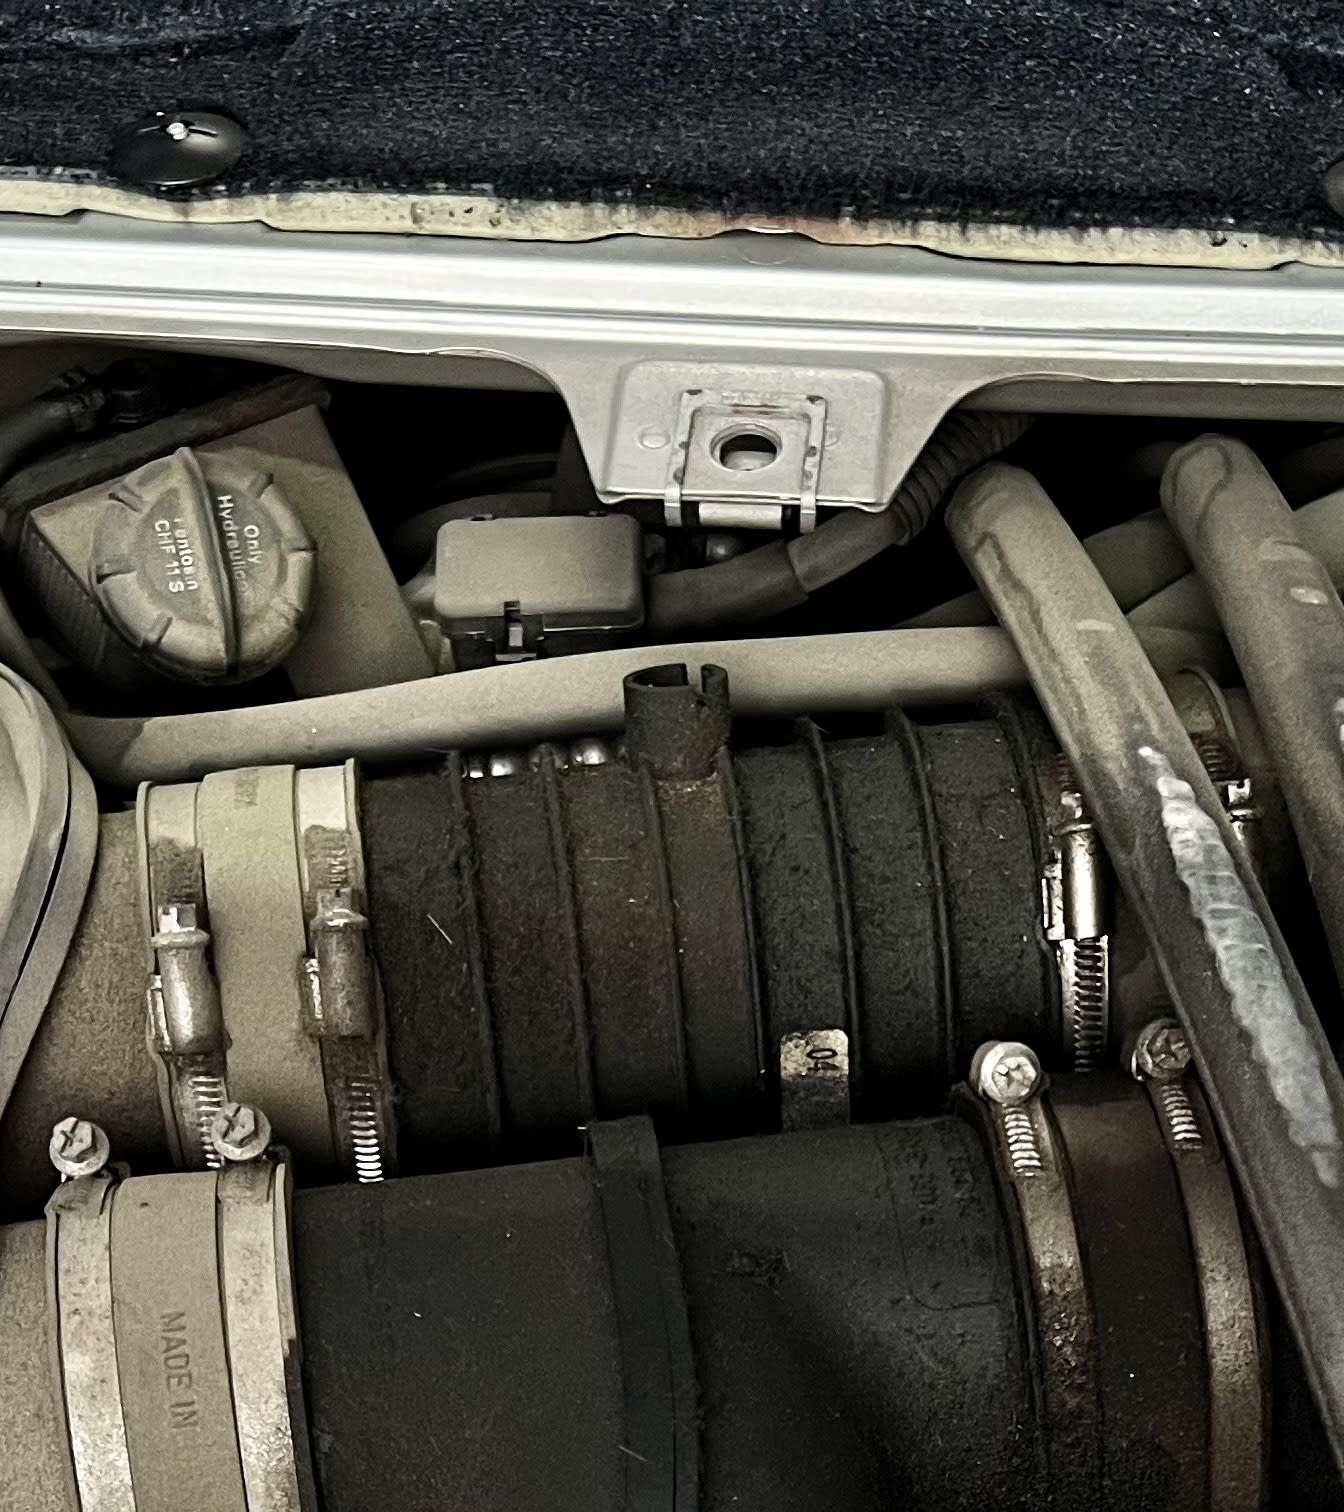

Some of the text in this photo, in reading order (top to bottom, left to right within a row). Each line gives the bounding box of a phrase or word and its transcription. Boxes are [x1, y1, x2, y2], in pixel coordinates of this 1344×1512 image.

[154, 519, 177, 555] CHF
[168, 580, 185, 593] S
[243, 524, 264, 564] Only
[160, 1310, 193, 1392] MADE
[169, 1400, 199, 1430] IN
